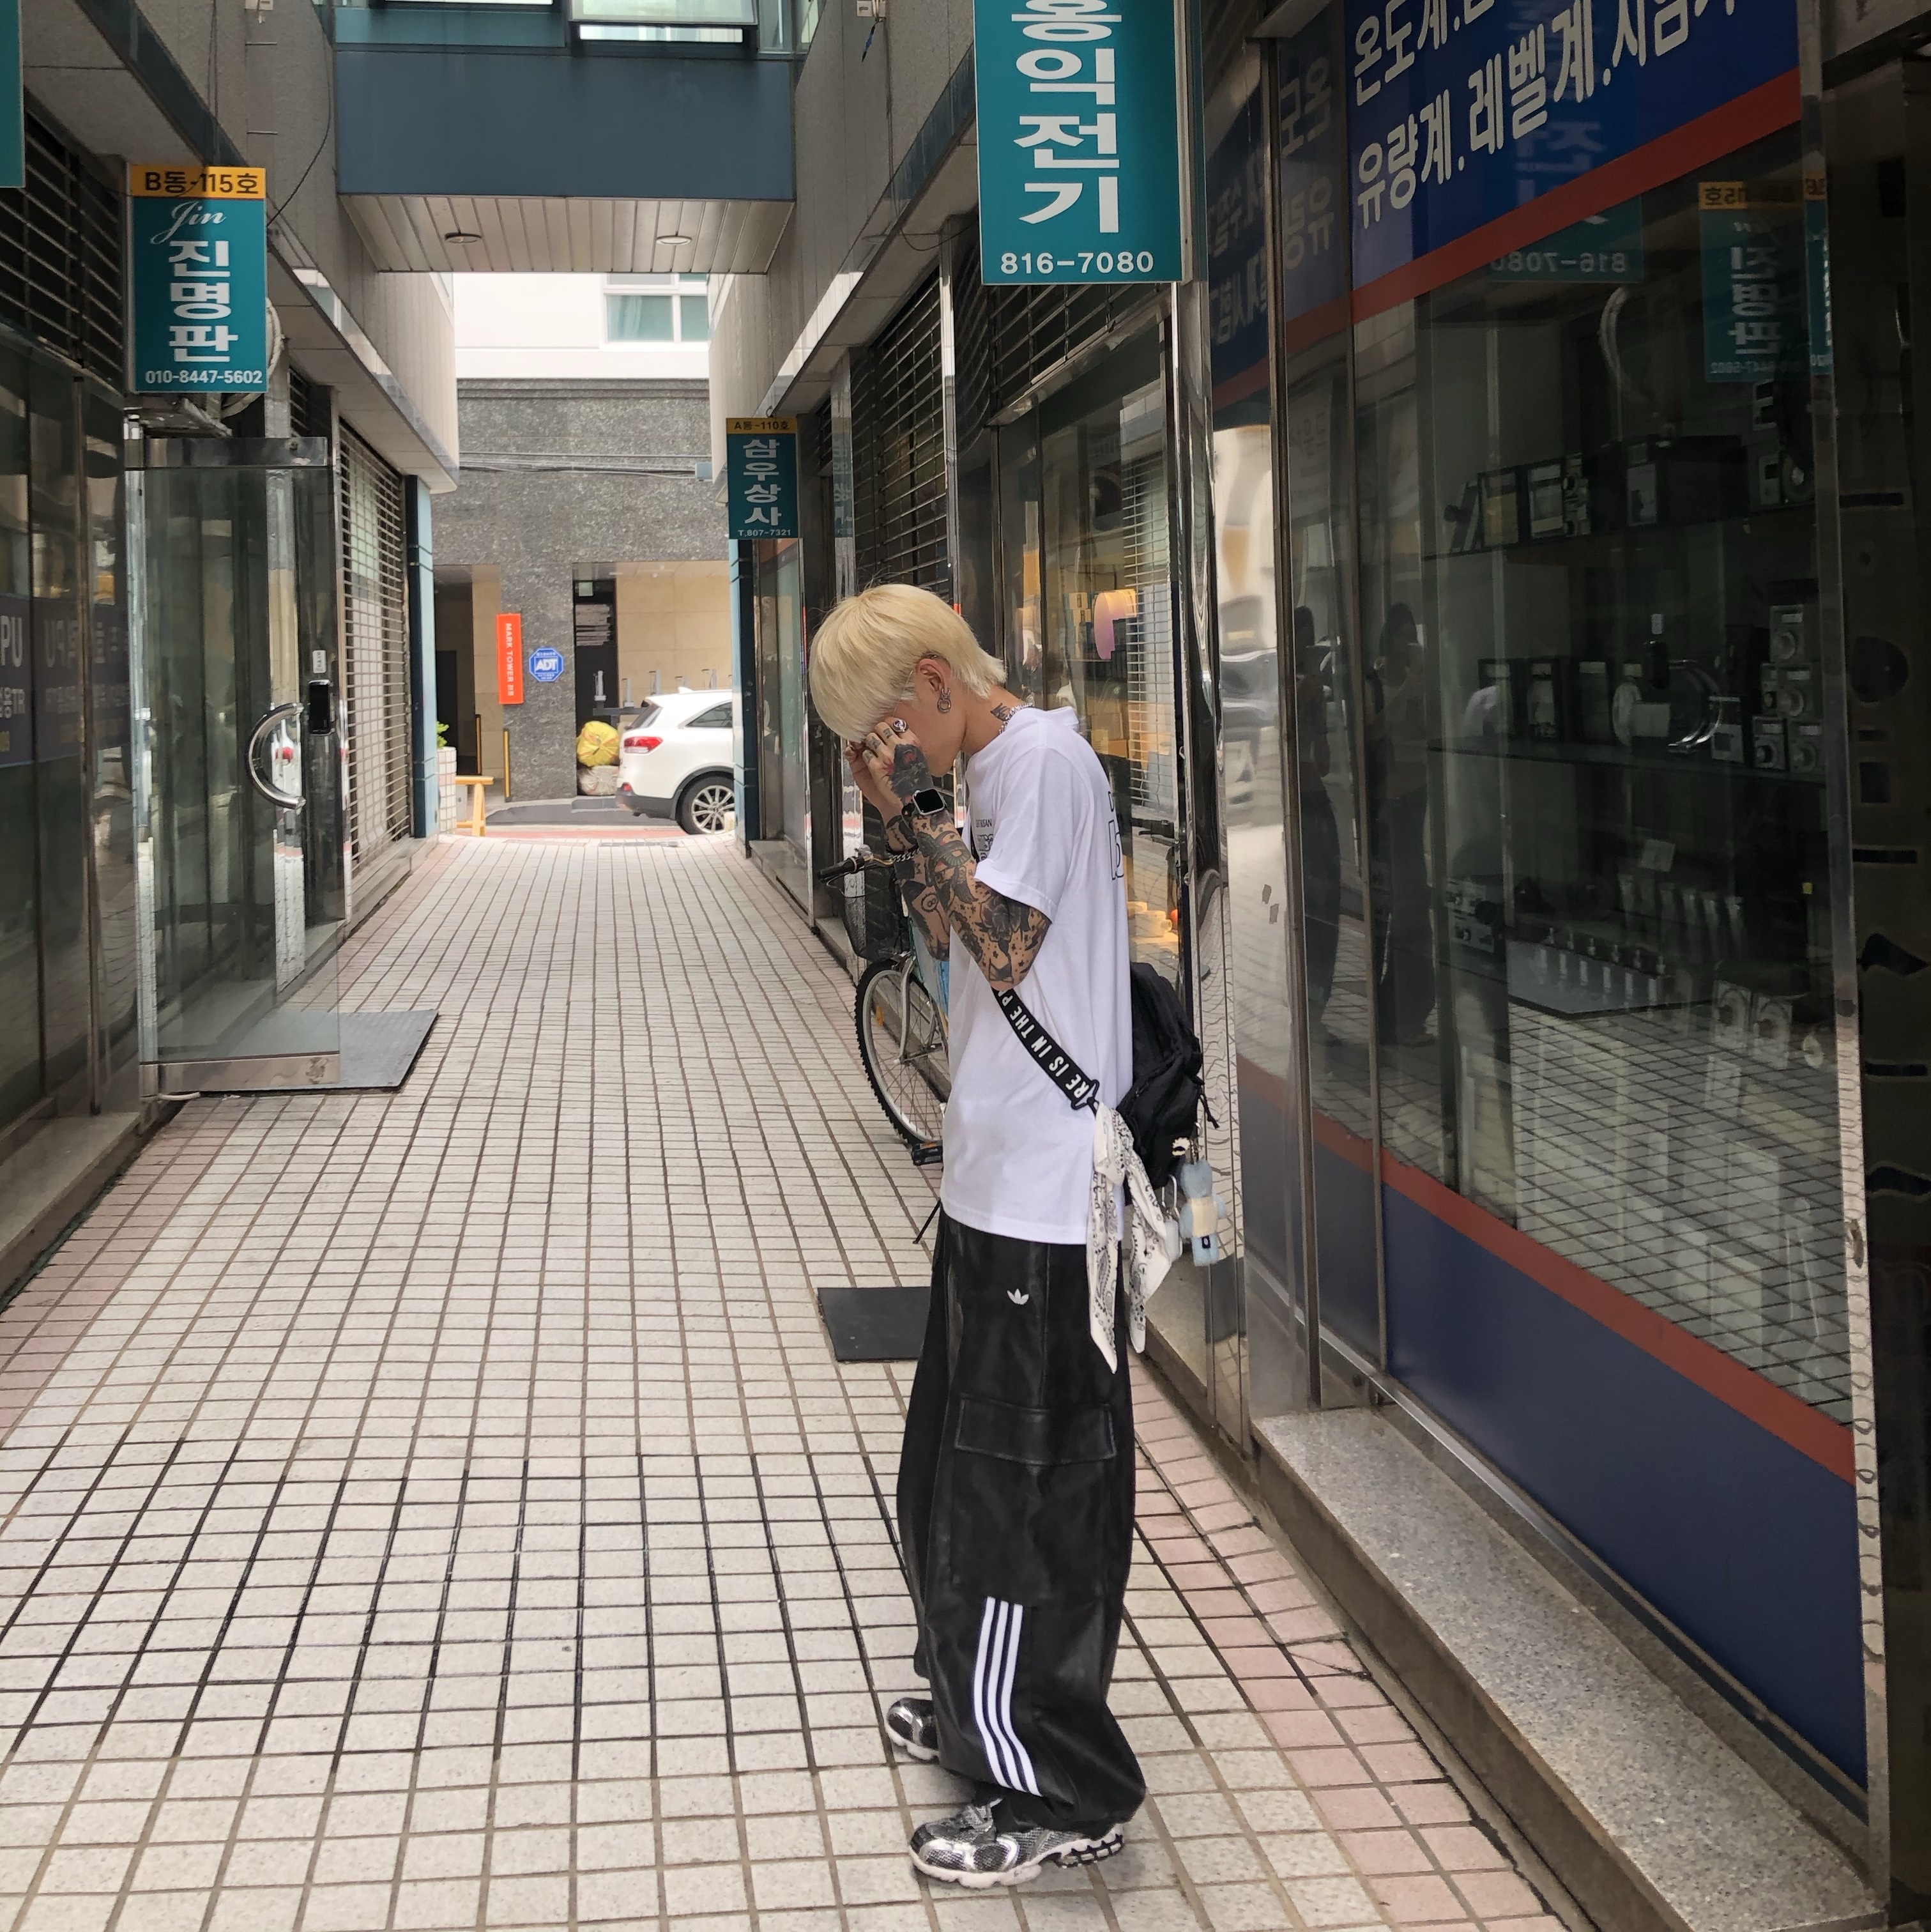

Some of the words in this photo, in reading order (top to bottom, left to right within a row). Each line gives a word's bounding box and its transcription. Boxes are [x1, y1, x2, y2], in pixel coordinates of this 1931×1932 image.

[149, 202, 227, 245] Jin
[1001, 251, 1154, 274] 816-7080
[168, 241, 239, 362] 진명판
[145, 370, 263, 384] 010-8447-5602
[743, 440, 781, 525] 삼우상사
[506, 651, 514, 682] TOWER
[535, 659, 558, 671] ADT
[1009, 1006, 1035, 1038] THE
[1031, 1036, 1052, 1057] IN
[1049, 1056, 1069, 1077] IS
